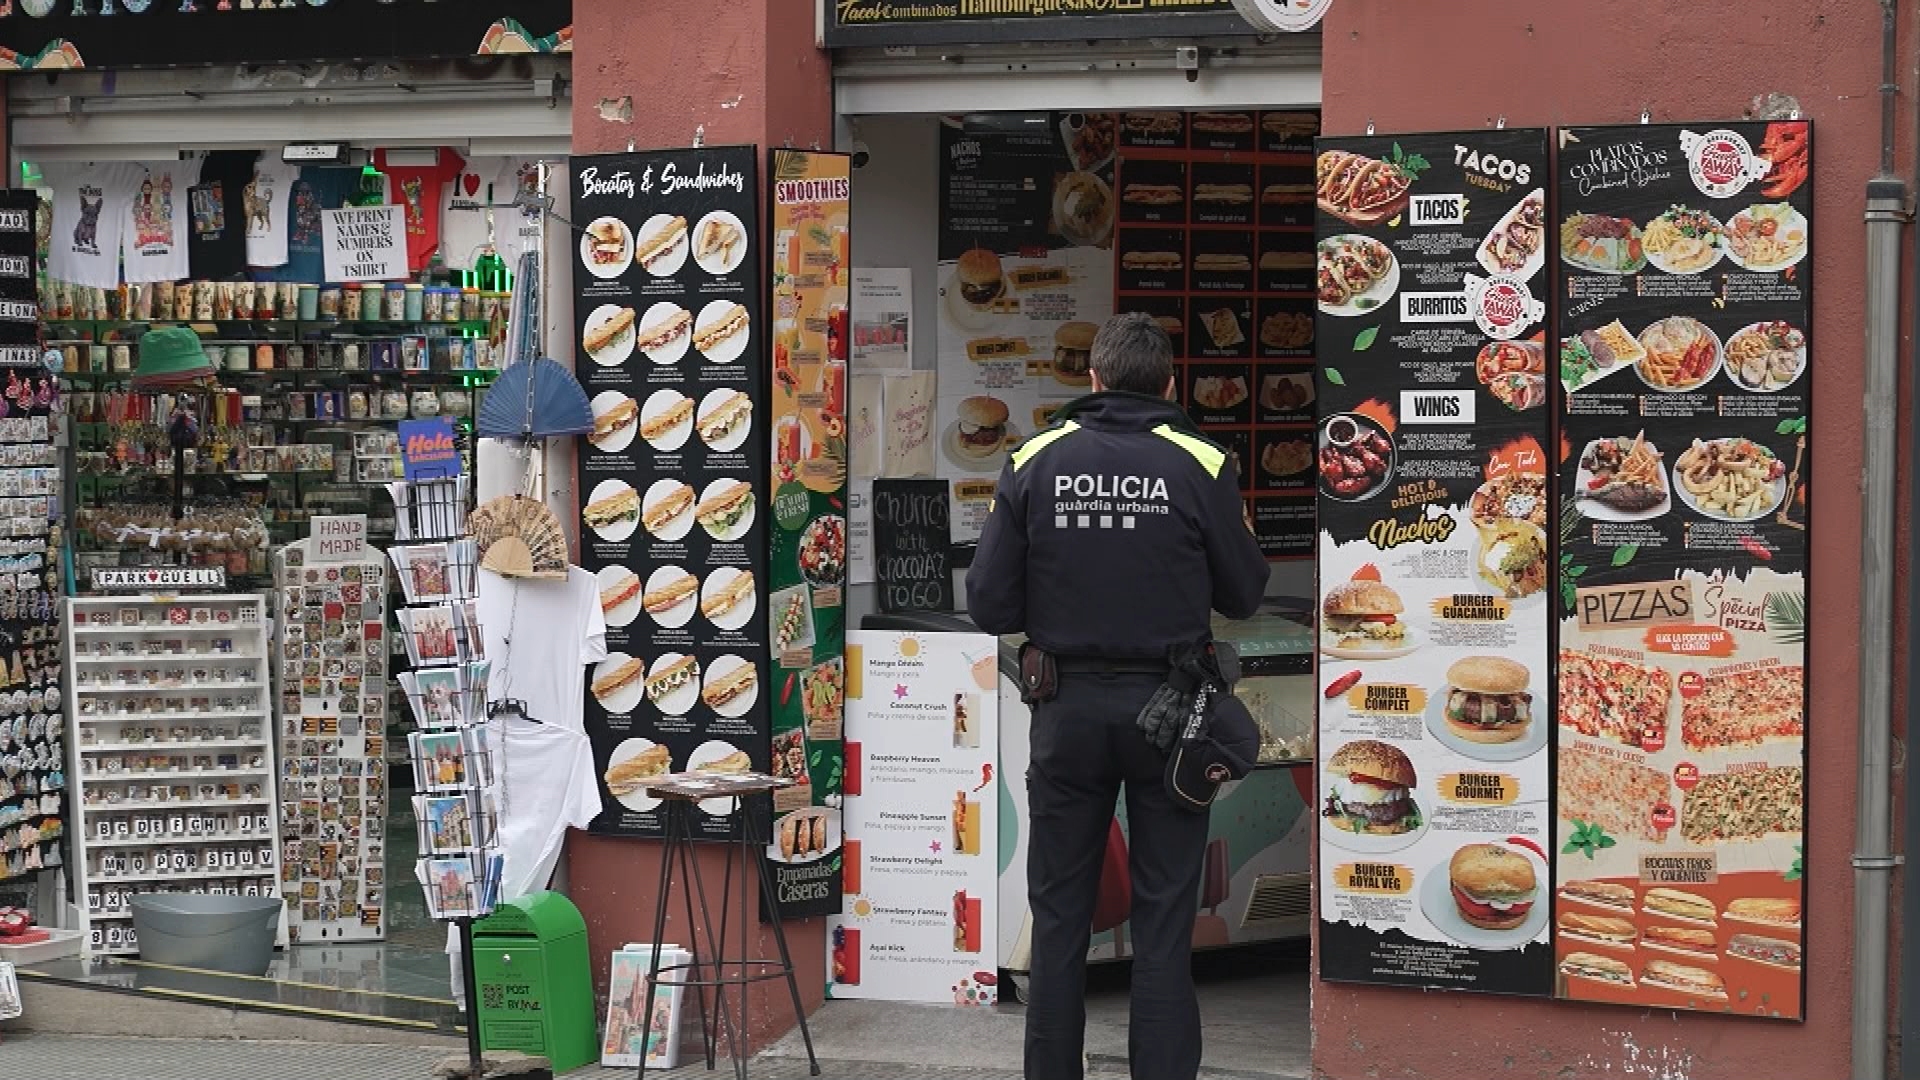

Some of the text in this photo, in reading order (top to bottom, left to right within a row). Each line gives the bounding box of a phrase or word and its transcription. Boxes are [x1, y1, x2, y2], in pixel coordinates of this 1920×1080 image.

[884, 3, 958, 20] Combinados
[1453, 143, 1532, 185] TACOS
[1702, 158, 1744, 178] AWAY
[580, 161, 745, 199] Bocatas & Sandwiches
[1464, 172, 1513, 193] TUESDAY
[778, 179, 849, 202] SMOOTHIES
[333, 208, 394, 224] WE PRINT
[1415, 199, 1460, 221] TACOS
[337, 223, 392, 237] NAMES &
[337, 236, 394, 251] NUMBERS
[356, 249, 374, 263] ON
[342, 262, 389, 277] TSHIRT
[1407, 296, 1468, 317] BURRITOS
[1413, 396, 1460, 417] WINGS
[407, 432, 455, 454] Hola
[1054, 473, 1170, 501] POLICIA
[1397, 481, 1425, 498] HOT
[1391, 487, 1449, 509] DELICIOUS
[1116, 500, 1170, 514] urbana
[320, 520, 362, 536] HAND
[1368, 514, 1457, 551] Nachos
[320, 538, 364, 557] MADE
[896, 530, 929, 553] with
[104, 571, 215, 584] PARK GUELL
[911, 581, 943, 608] GO
[1452, 594, 1495, 607] BURGER
[1583, 586, 1690, 625] PIZZAS
[1442, 607, 1505, 621] GUACAMOLE
[1724, 617, 1767, 633] PIZZA
[870, 659, 896, 669] Mango
[1367, 685, 1408, 699] BURGER
[890, 701, 948, 711] Coconut Crush
[1364, 699, 1411, 712] COMPLET
[1459, 773, 1501, 787] BURGER
[1454, 786, 1505, 801] GOURMET
[879, 812, 947, 822] Pineapple Sunset
[100, 823, 109, 834] B
[117, 823, 127, 834] C
[138, 822, 147, 832] D
[154, 822, 161, 832] E
[174, 820, 181, 830] F
[192, 820, 200, 830] G
[205, 820, 213, 830] H
[241, 818, 248, 829] J
[259, 817, 267, 828] K
[105, 851, 270, 871] M N P Q R S T U V
[870, 856, 943, 867] Strawberry Delight
[1645, 857, 1713, 871] BOCATAS FRIOS
[777, 862, 833, 885] Empanadas
[1354, 863, 1395, 877] BURGER
[1651, 869, 1707, 883] Y CALIENTES
[1349, 876, 1401, 891] ROYAL VEG
[89, 885, 273, 907] W X 6 7
[778, 881, 829, 903] Caseras
[873, 907, 948, 917] Strawberry Fantasy
[92, 931, 100, 942] 8
[112, 930, 120, 941] 9
[505, 985, 531, 996] POST
[507, 1000, 520, 1010] BY
